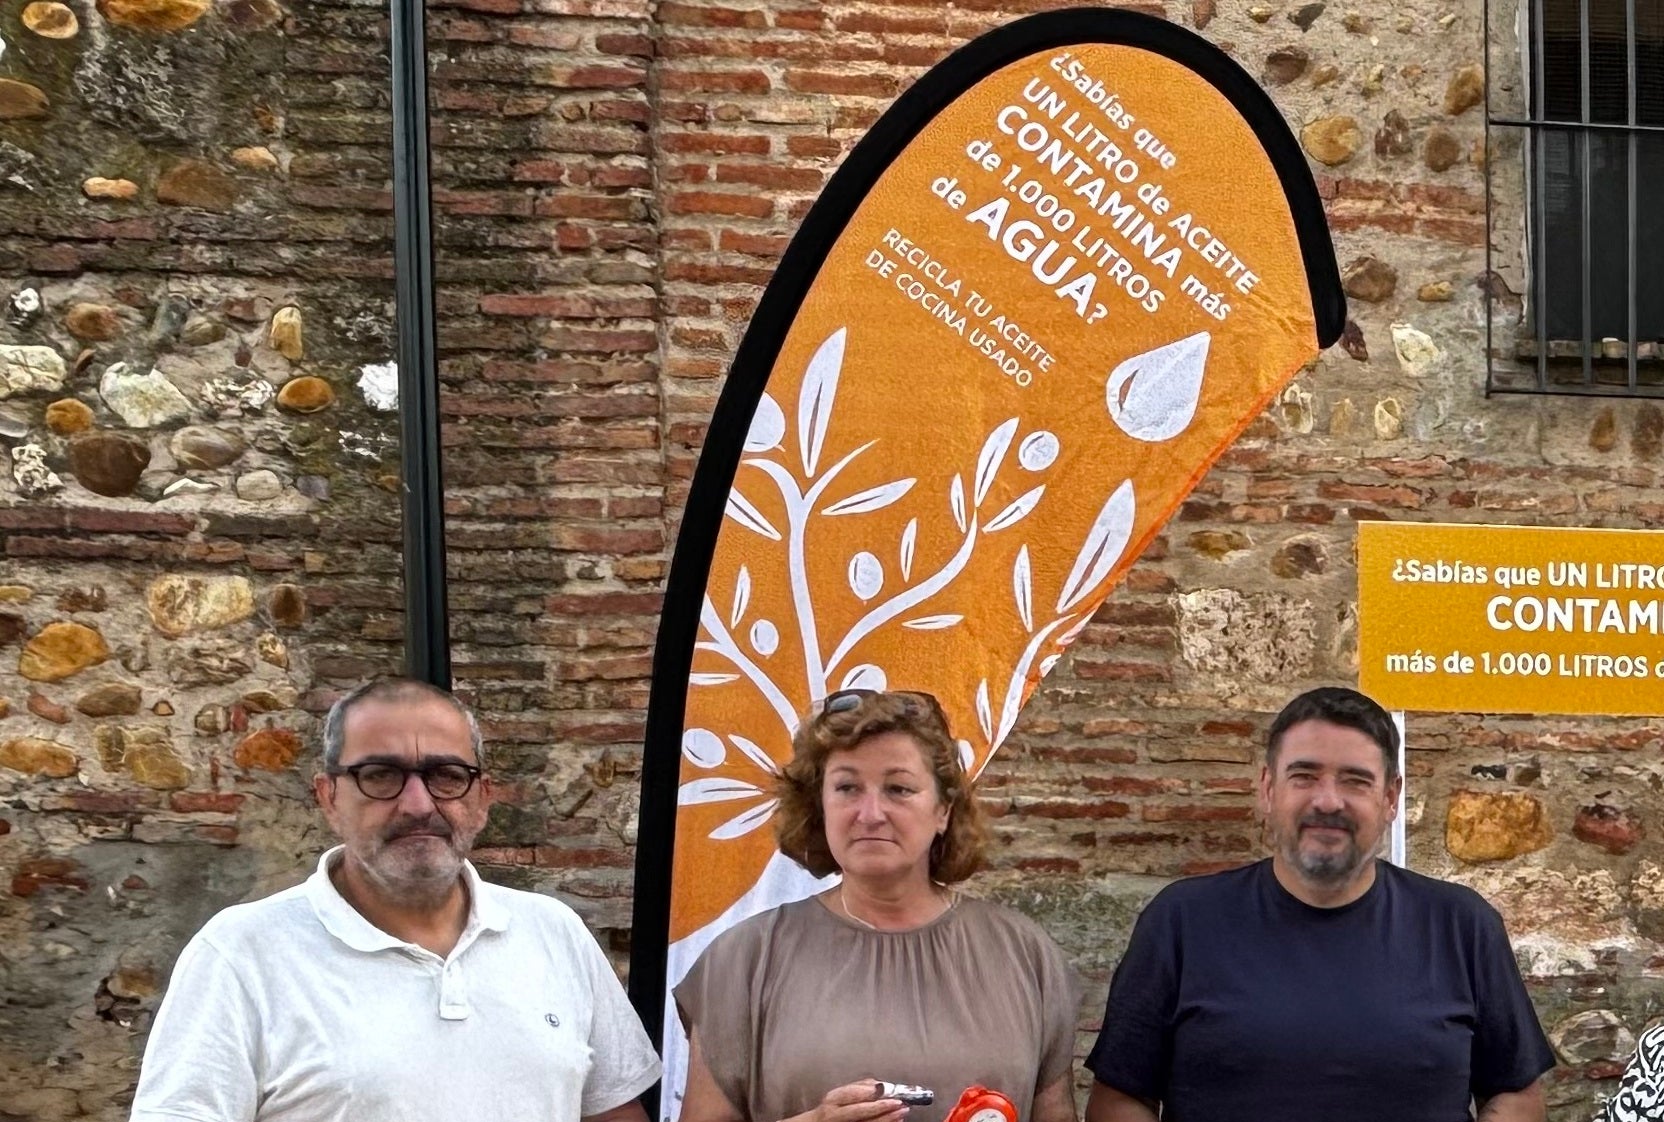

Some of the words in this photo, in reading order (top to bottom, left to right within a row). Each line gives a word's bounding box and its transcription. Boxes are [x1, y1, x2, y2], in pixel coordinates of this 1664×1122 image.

[1050, 52, 1135, 131] ¿Sabías
[1134, 125, 1177, 170] que
[930, 174, 967, 211] de
[965, 196, 1108, 326] AGUA?
[965, 138, 1000, 174] de
[1000, 165, 1076, 233] 1.000
[1071, 228, 1165, 314] LITROS
[997, 106, 1181, 278] CONTAMINA
[1180, 272, 1233, 321] más
[1023, 76, 1068, 121] UN
[1062, 111, 1139, 184] LITRO
[1140, 177, 1169, 216] de
[1168, 211, 1261, 295] ACEITE
[865, 249, 894, 279] DE
[894, 273, 964, 337] COCINA
[969, 329, 1033, 388] USADO
[882, 228, 962, 298] RECICLA
[965, 291, 993, 320] TU
[988, 312, 1056, 373] ACEITE
[1392, 558, 1488, 584] ¿Sabías
[1495, 566, 1541, 591] que
[1548, 562, 1588, 588] UN
[1387, 649, 1436, 673] más
[1443, 650, 1474, 674] de
[1483, 653, 1551, 676] 1.000
[1559, 655, 1648, 679] LITROS
